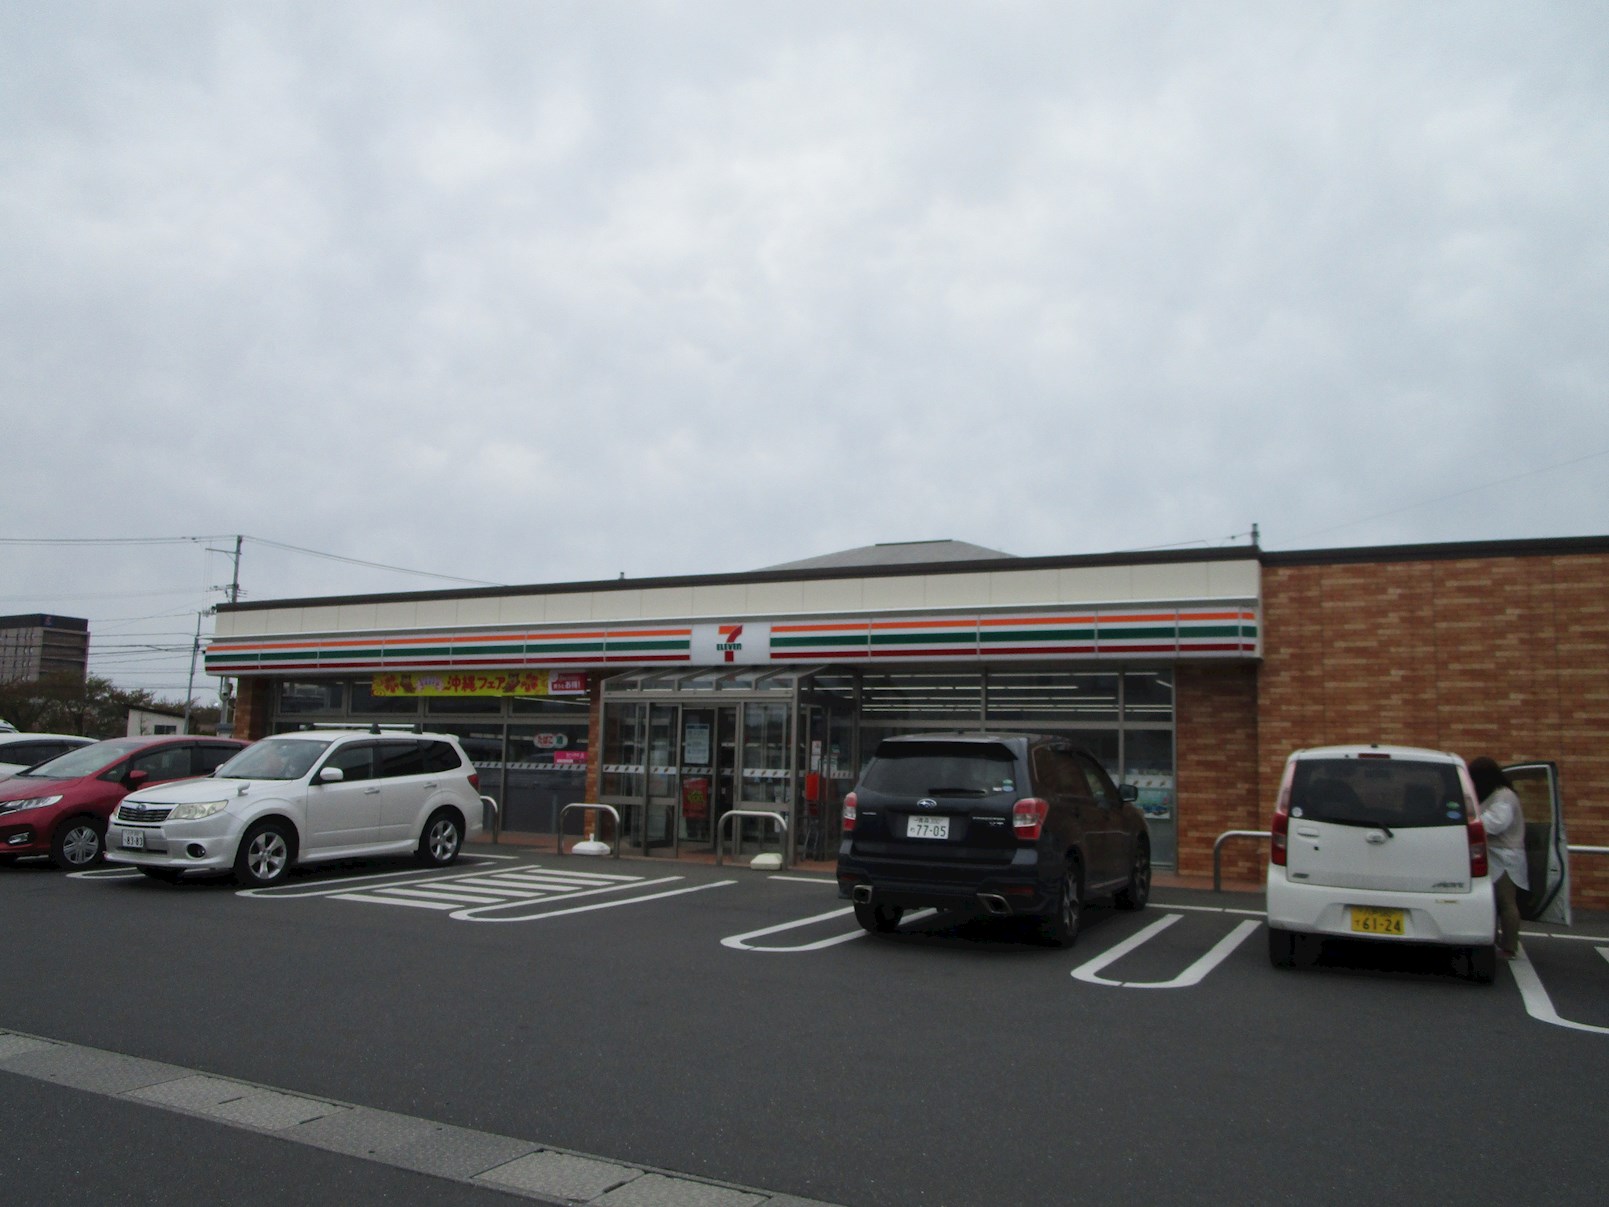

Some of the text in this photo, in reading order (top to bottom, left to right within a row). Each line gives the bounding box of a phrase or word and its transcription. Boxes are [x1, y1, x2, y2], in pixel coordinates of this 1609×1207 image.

[718, 624, 743, 662] 7
[443, 674, 506, 693] 沖縄フェア
